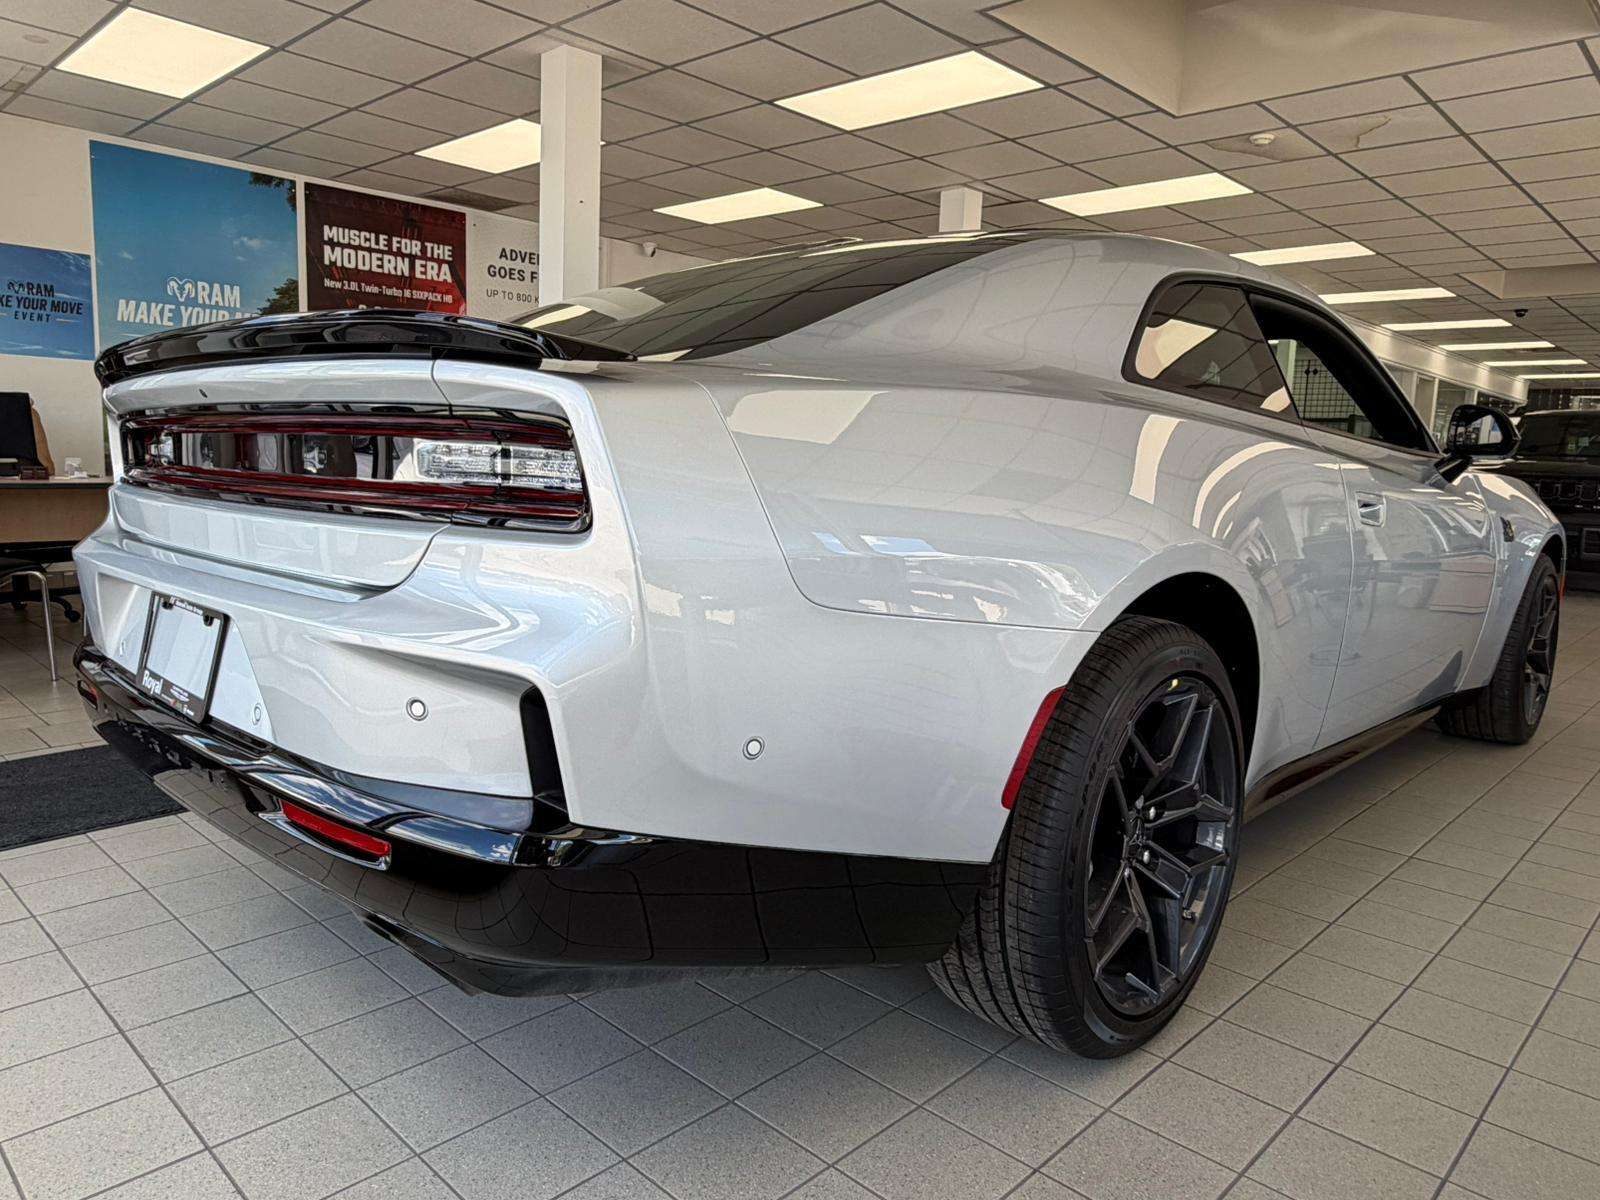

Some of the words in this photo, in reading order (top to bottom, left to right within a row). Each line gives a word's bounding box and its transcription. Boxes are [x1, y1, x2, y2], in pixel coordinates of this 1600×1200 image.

[323, 224, 389, 251] MUSCLE
[392, 236, 422, 257] FOR
[424, 241, 453, 261] THE
[323, 244, 410, 277] MODERN
[415, 259, 453, 284] ERA
[487, 264, 526, 282] GOES
[26, 281, 55, 298] RAM
[197, 281, 240, 308] RAM
[324, 278, 342, 290] New
[343, 281, 360, 292] 3.0L
[361, 283, 403, 297] Twin-Turbo
[412, 290, 443, 302] SIXPACK
[486, 289, 499, 298] UP
[502, 290, 514, 301] TO
[516, 292, 532, 303] 800
[14, 310, 52, 323] EVENT
[16, 295, 48, 311] YOUR
[50, 300, 84, 315] MOVE
[117, 299, 176, 327] MAKE
[142, 669, 164, 695] Royal
